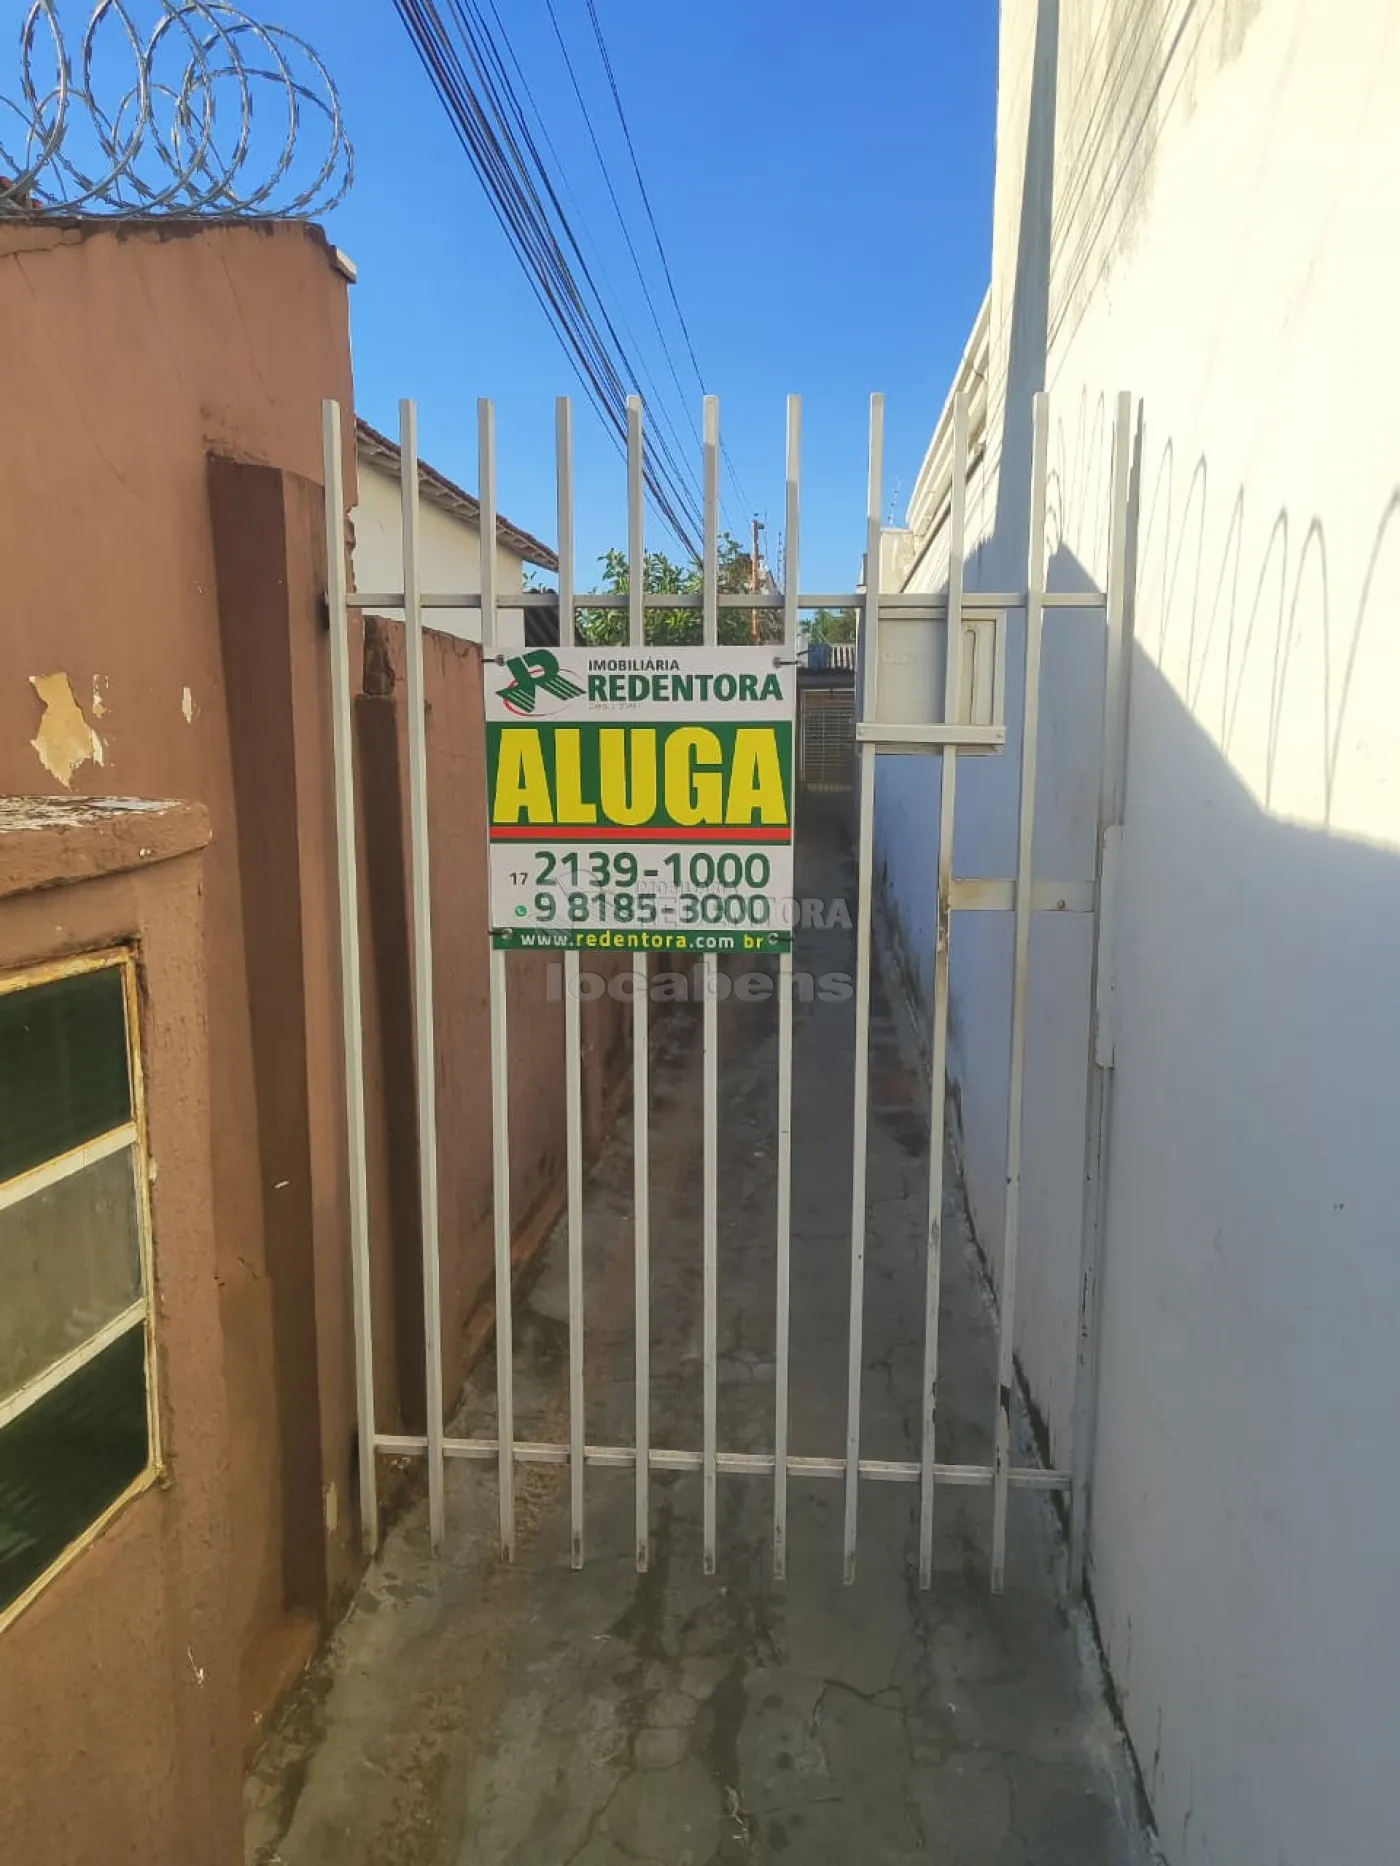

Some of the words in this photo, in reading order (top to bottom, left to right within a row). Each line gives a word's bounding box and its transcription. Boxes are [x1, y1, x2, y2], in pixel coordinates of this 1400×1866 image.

[588, 673, 783, 702] REDENTORA
[493, 726, 788, 826] ALUGA
[509, 872, 528, 885] 17
[534, 851, 770, 888] 2139-1000
